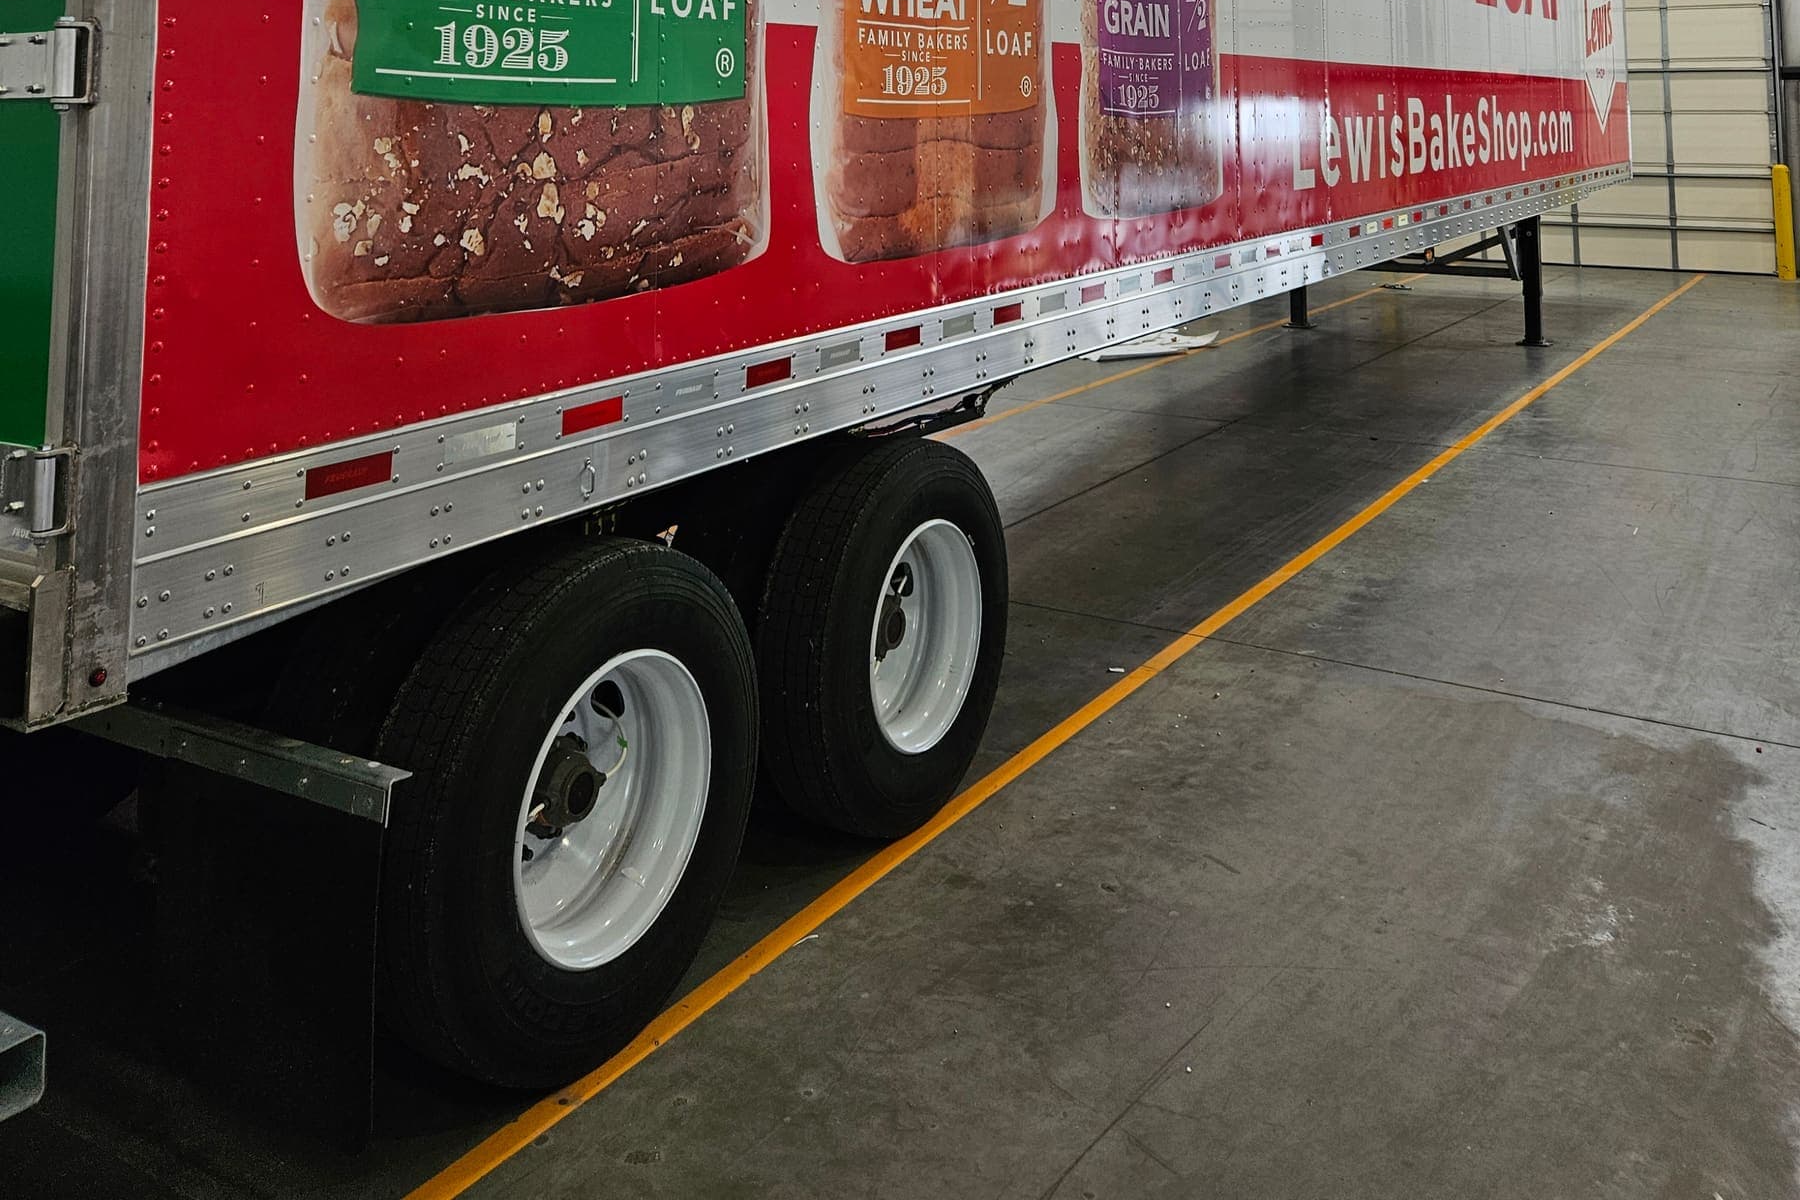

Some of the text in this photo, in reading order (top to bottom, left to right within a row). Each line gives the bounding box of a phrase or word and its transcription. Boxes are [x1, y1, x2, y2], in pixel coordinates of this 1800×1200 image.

[476, 3, 536, 23] SINCE
[434, 21, 569, 72] 1925
[858, 27, 968, 51] FAMILY BAKERS
[986, 29, 1032, 56] LOAF
[900, 50, 931, 63] SINCE
[1102, 56, 1173, 71] FAMILY BAKERS
[882, 64, 947, 96] 1925
[1128, 72, 1148, 83] SINCE
[1117, 83, 1159, 109] 1925
[1292, 94, 1574, 191] LewisBakeShop.com
